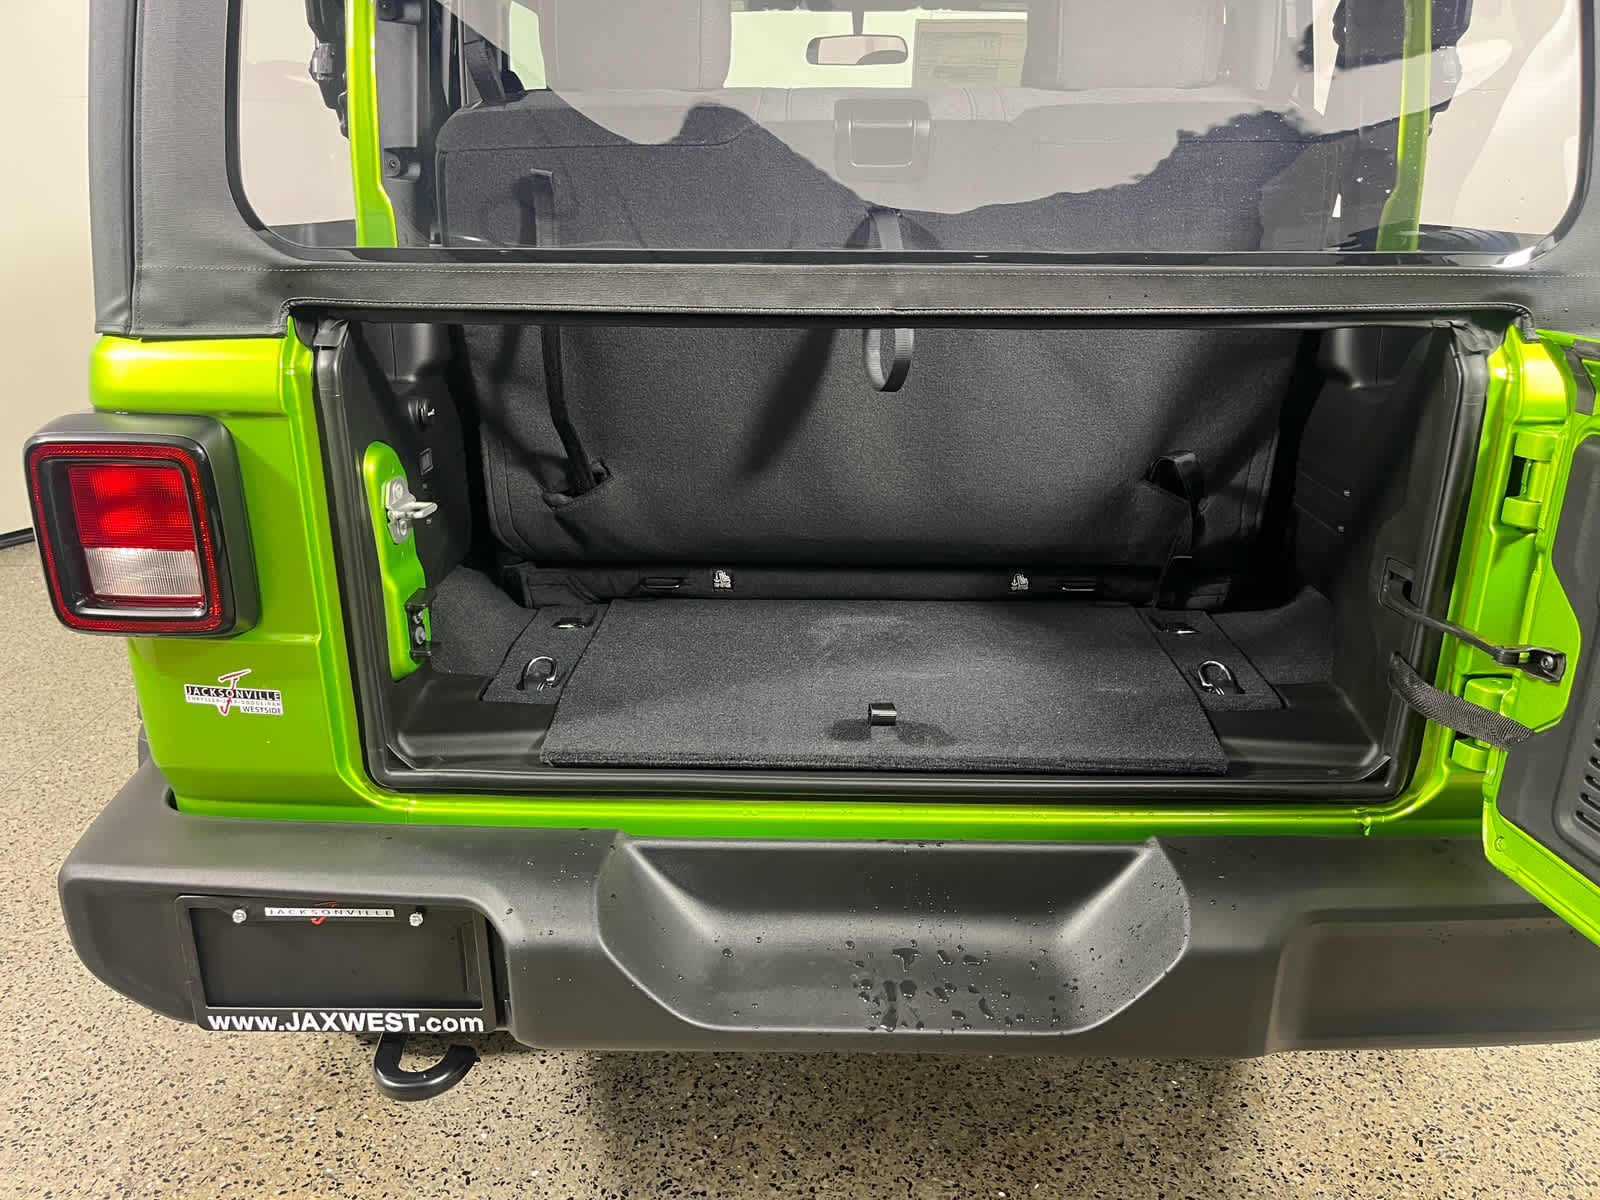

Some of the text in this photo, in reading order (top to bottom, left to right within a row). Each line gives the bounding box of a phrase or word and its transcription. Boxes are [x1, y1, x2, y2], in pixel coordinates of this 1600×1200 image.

[186, 686, 281, 701] JACKSONVILLE
[242, 705, 282, 714] WESTSIDE
[269, 908, 393, 916] JACKSONVILLE
[207, 1012, 484, 1032] www.JAXWEST.com
